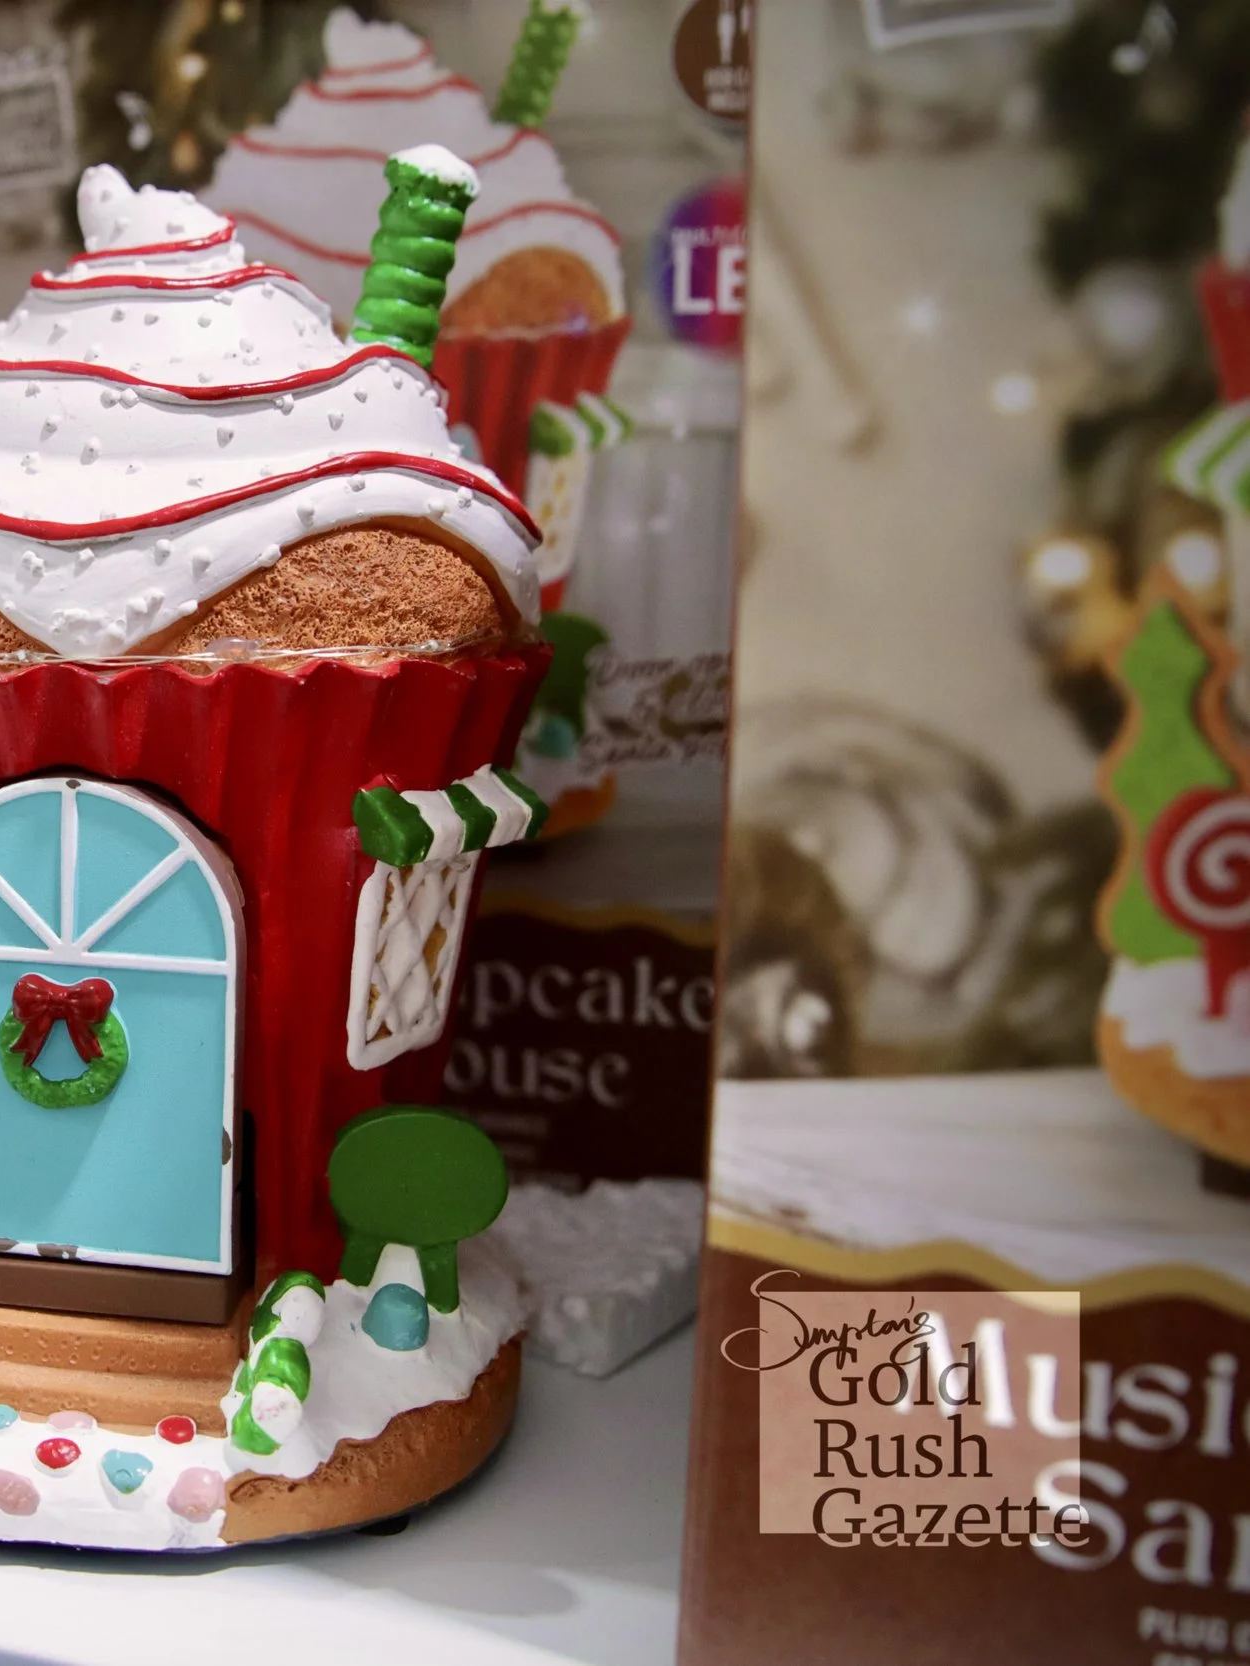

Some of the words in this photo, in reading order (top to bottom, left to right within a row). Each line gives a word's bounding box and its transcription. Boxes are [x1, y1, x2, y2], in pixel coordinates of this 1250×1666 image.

[673, 244, 747, 315] LE
[470, 955, 716, 1034] pcake
[443, 1037, 630, 1108] ouse
[892, 1310, 1250, 1458] Musi
